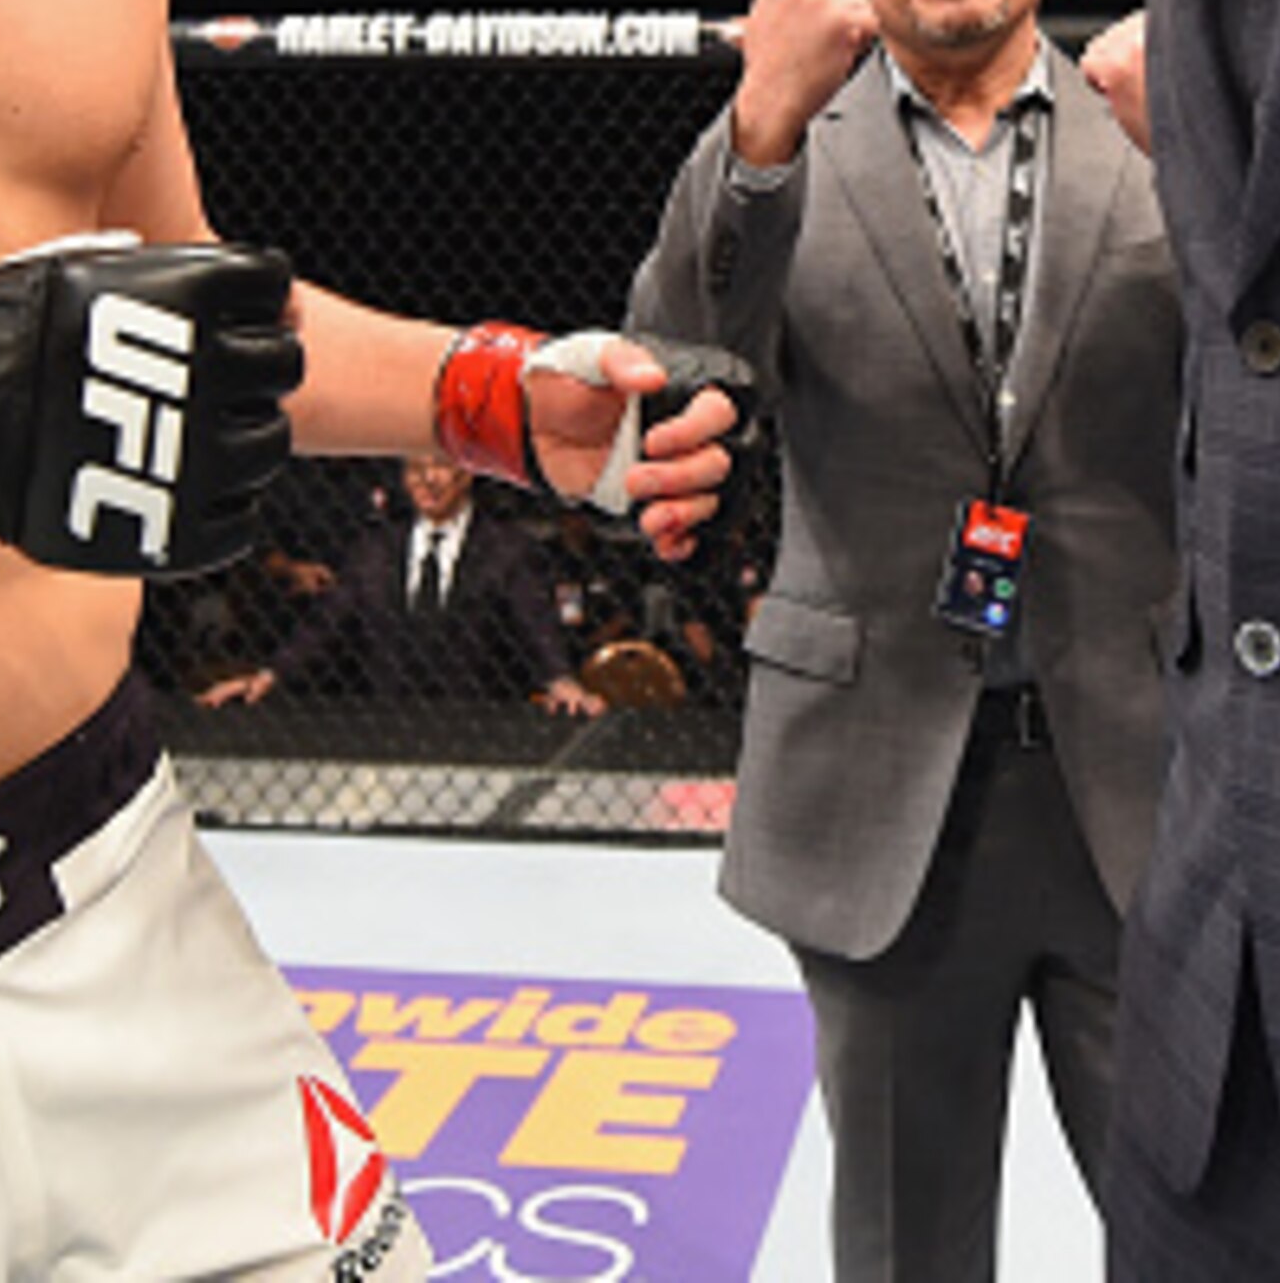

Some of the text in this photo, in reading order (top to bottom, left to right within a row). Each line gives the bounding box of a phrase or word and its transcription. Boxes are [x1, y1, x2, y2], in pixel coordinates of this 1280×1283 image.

[276, 11, 700, 55] HARLEY-DAVIDSON.COM
[69, 292, 195, 562] UFC
[348, 1038, 724, 1176] TE
